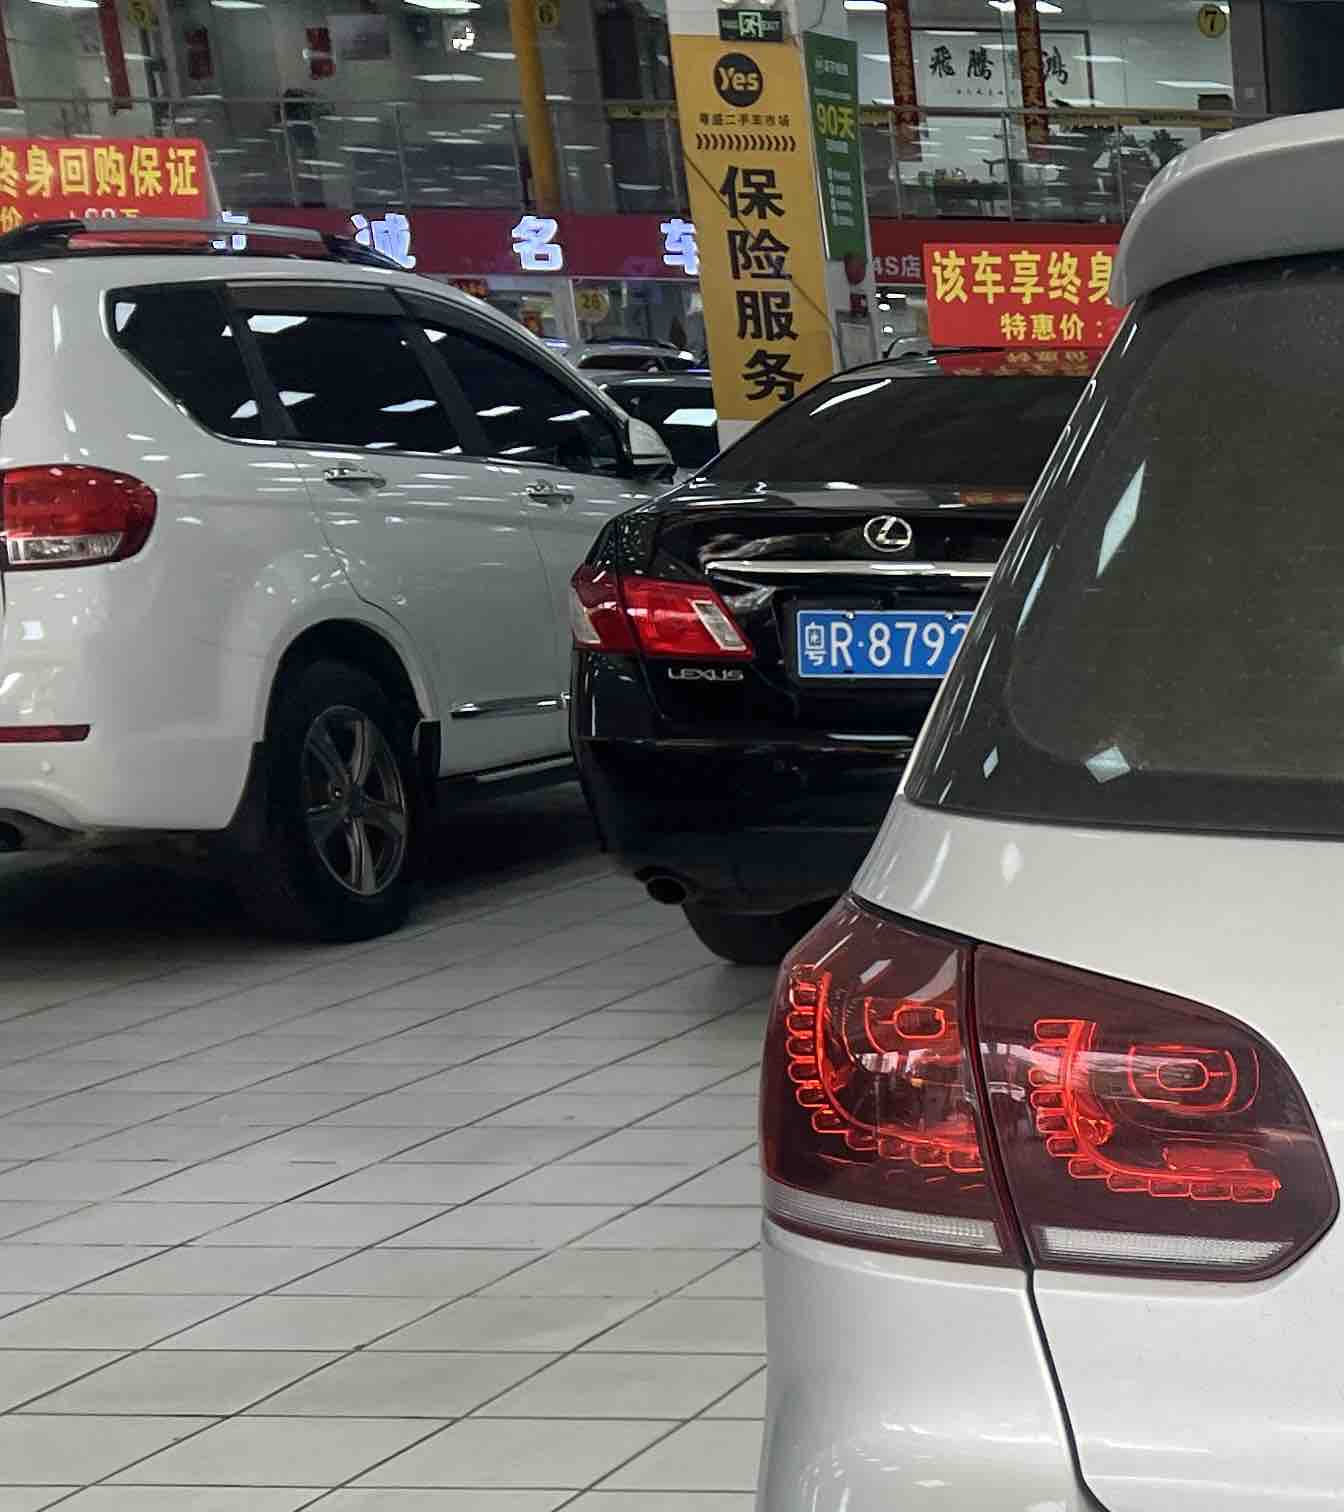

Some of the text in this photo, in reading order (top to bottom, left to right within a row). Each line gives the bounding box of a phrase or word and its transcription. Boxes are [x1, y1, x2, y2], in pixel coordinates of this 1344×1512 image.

[718, 66, 760, 91] Yes
[719, 165, 804, 402] 保险服务
[931, 250, 1113, 304] 该车享终身
[667, 666, 744, 681] LEXUS
